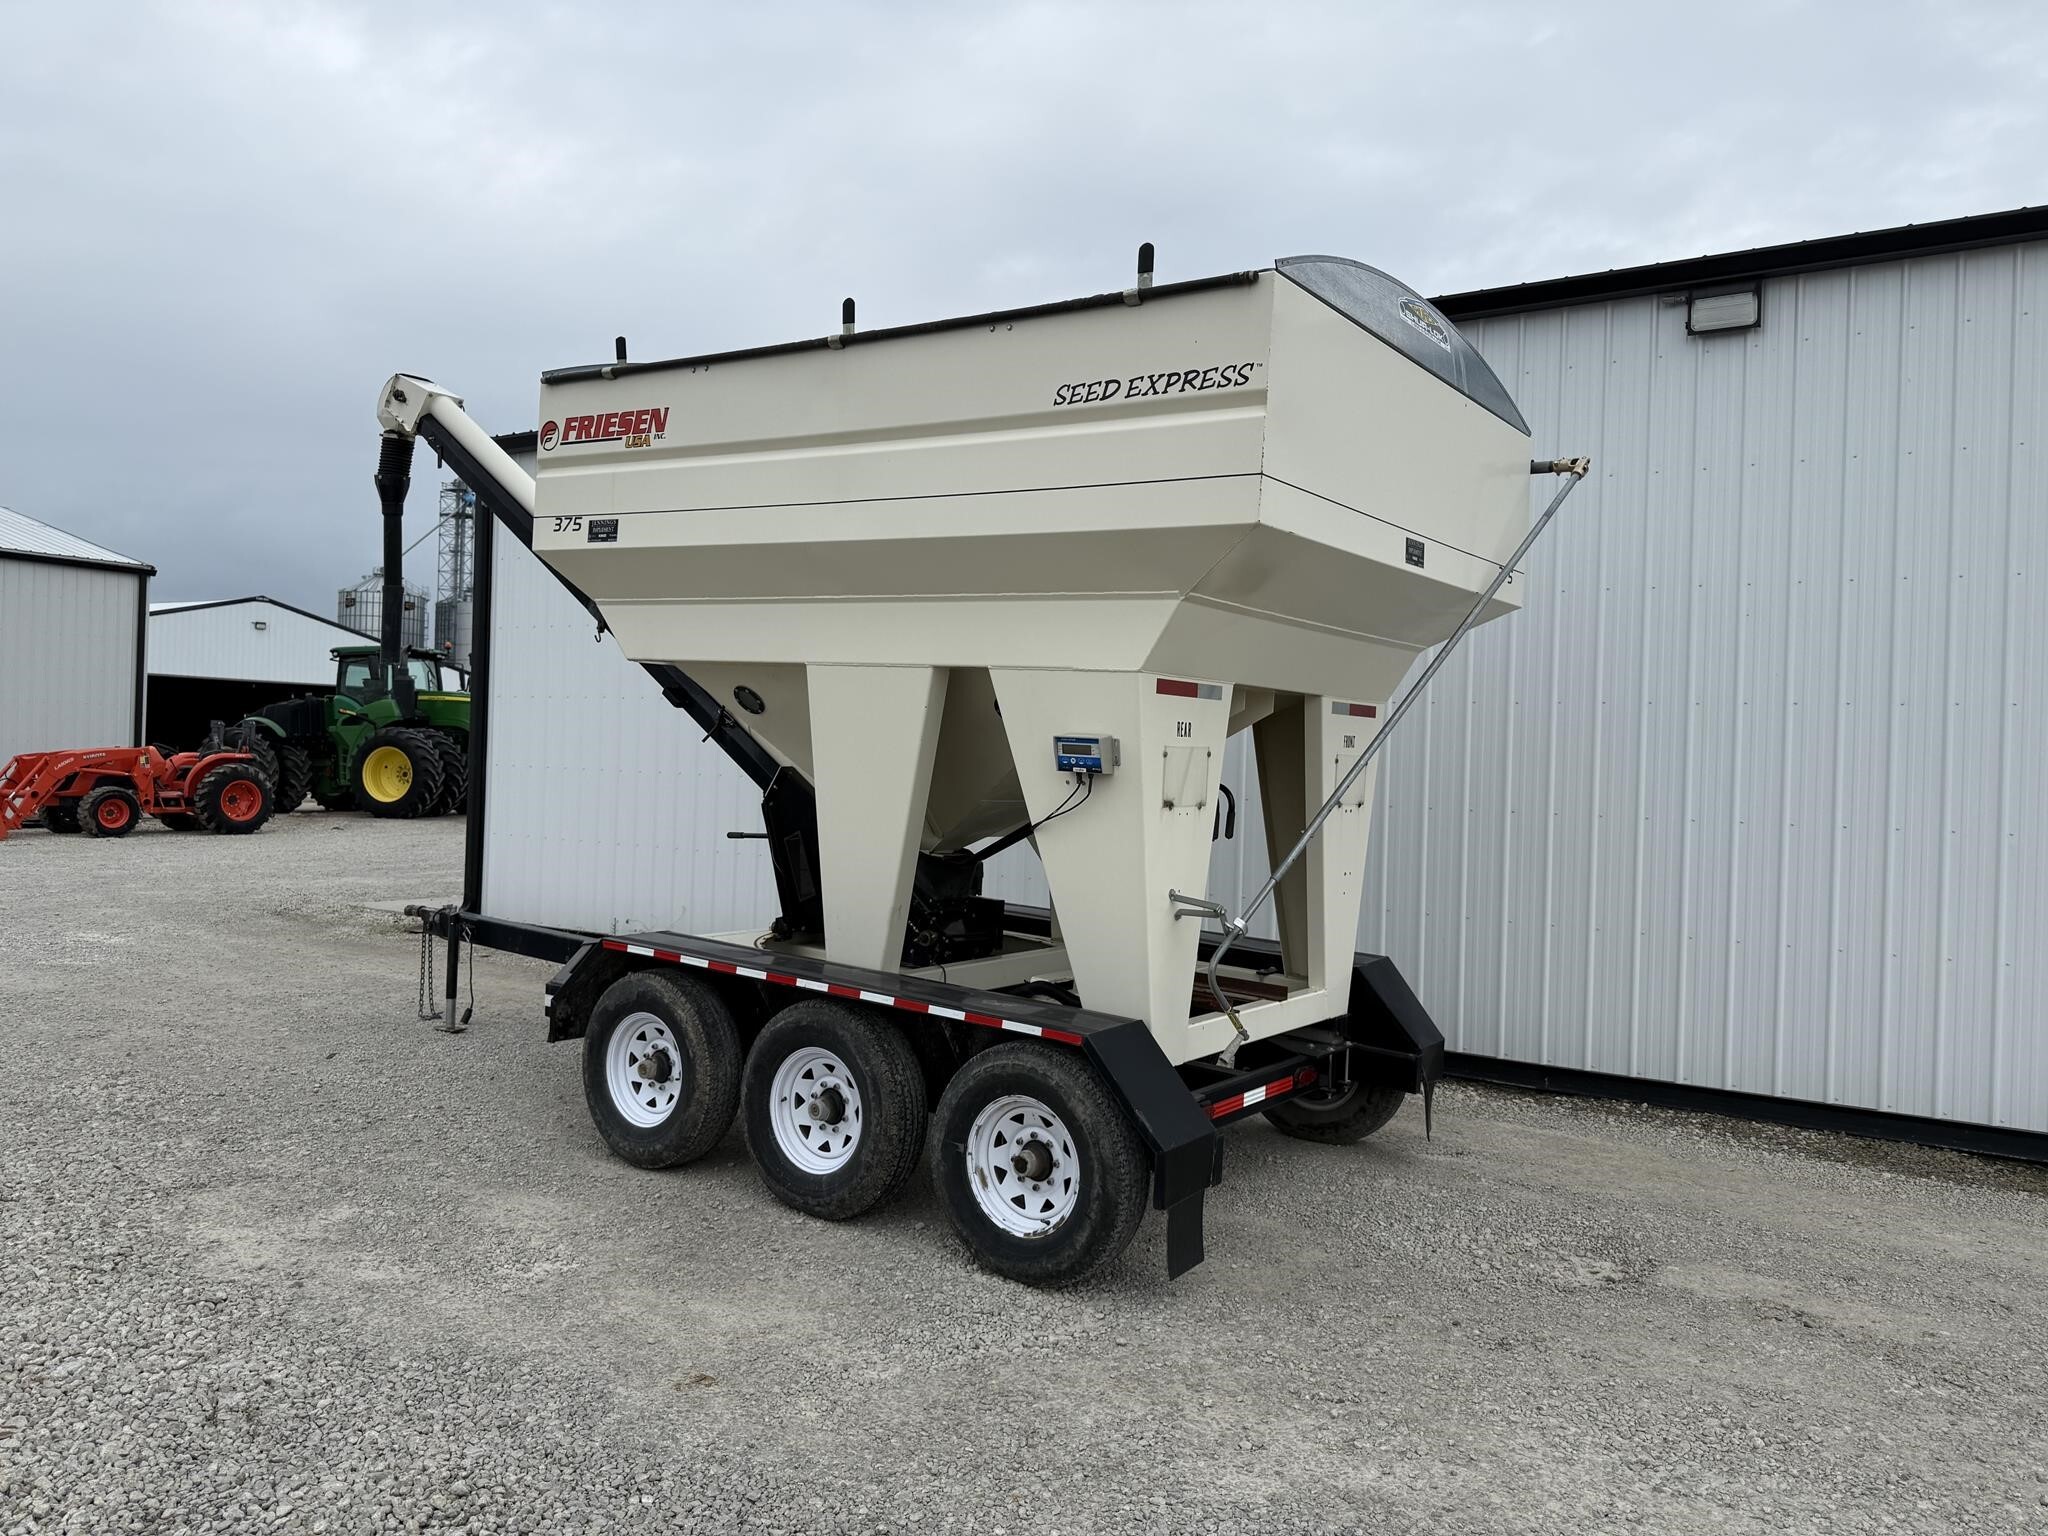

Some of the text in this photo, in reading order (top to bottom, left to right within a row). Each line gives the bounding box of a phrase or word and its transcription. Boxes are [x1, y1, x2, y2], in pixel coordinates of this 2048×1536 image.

[1053, 379, 1122, 406] SEED
[1124, 362, 1255, 399] EXPRESS
[560, 407, 670, 441] FRIESEN
[625, 434, 651, 448] USA
[553, 517, 582, 532] 375
[1176, 721, 1192, 738] REAR
[1343, 735, 1356, 748] FRONT
